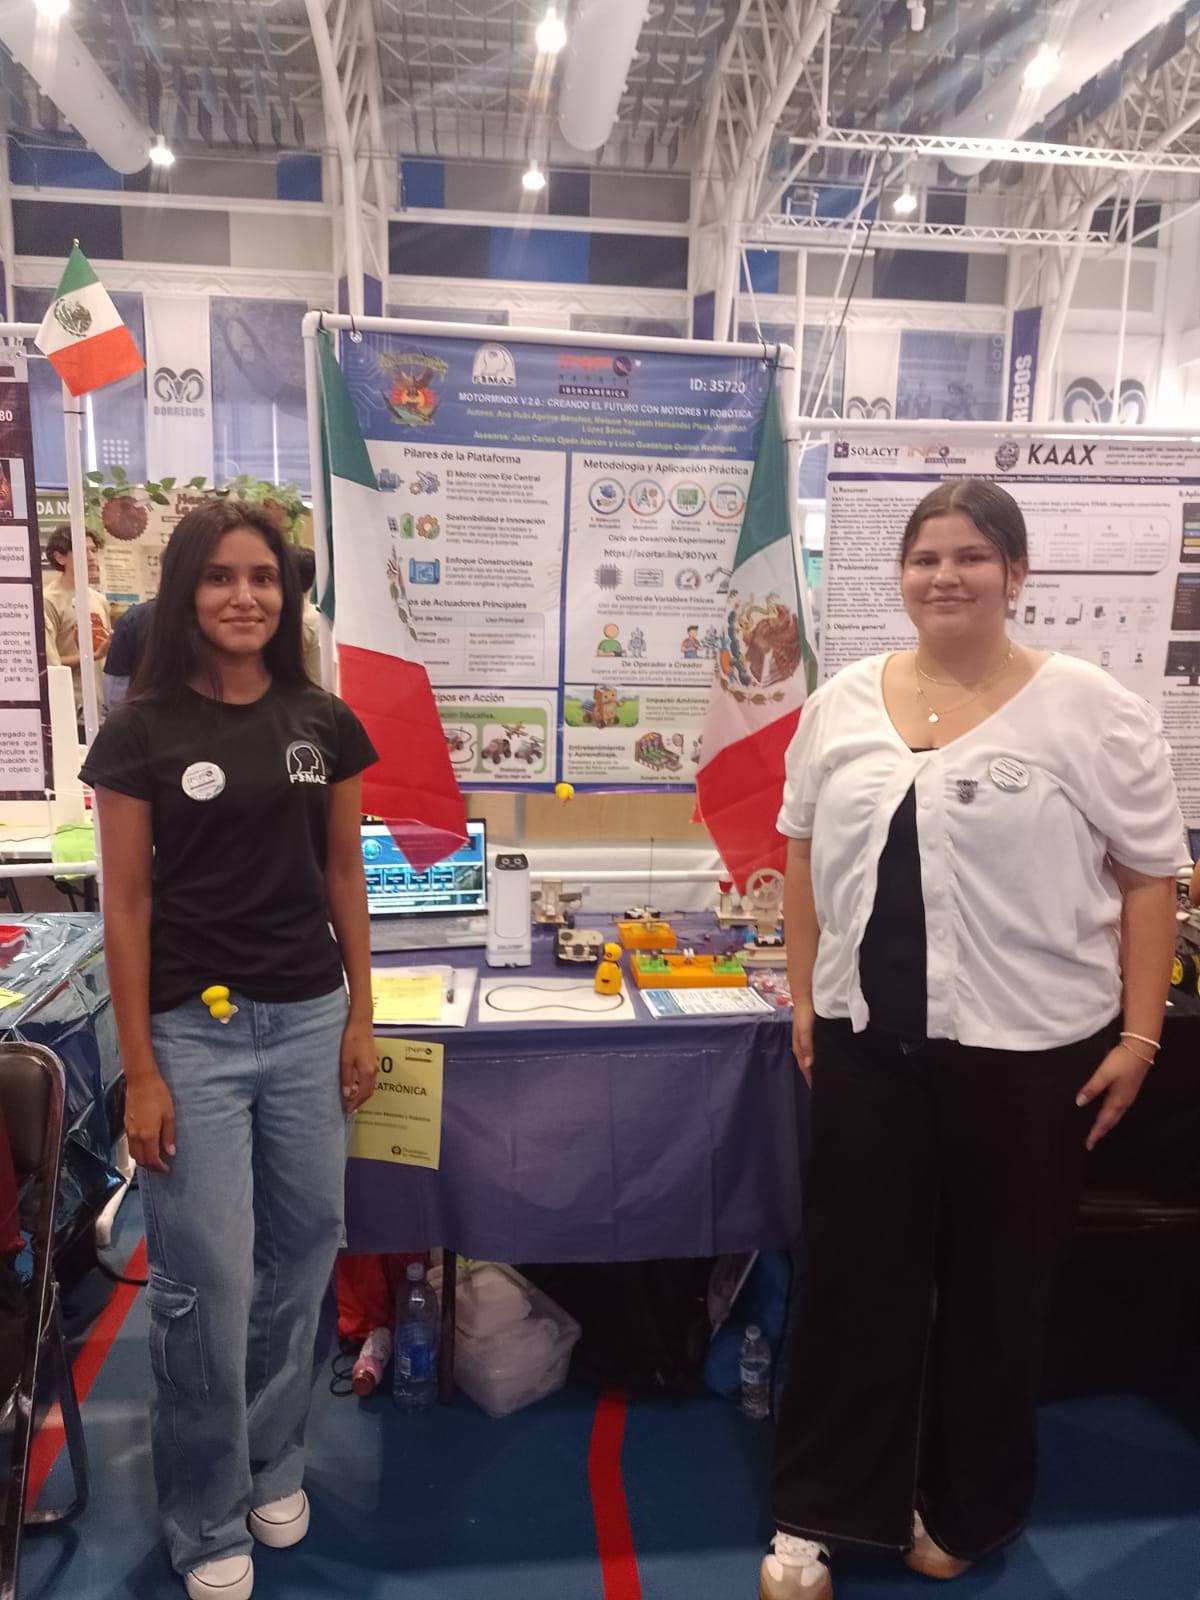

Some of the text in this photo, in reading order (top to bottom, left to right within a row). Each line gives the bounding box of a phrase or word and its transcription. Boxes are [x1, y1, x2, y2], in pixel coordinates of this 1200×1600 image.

[690, 378, 746, 394] ID: 35720
[154, 406, 206, 417] BORREGOS
[547, 398, 590, 410] CREANDO
[592, 401, 603, 410] EL
[605, 401, 638, 412] FUTURO
[641, 402, 659, 413] CON
[661, 405, 701, 417] MOTORES
[703, 408, 708, 417] Y
[404, 448, 521, 464] Pilares de la Plataforma
[850, 447, 900, 457] SOLACYT
[1028, 443, 1097, 466] KAAX
[584, 459, 749, 476] Metodología y Aplicación Práctica
[456, 471, 478, 479] Motor
[501, 473, 512, 481] Eje
[514, 474, 541, 482] Central
[446, 514, 498, 522] Sostenibilidad
[506, 516, 546, 525] Innovación
[640, 535, 678, 544] Desarrollo
[678, 536, 726, 546] Experimental
[446, 556, 534, 566] Enfoque Constructivista
[421, 598, 431, 607] de
[434, 598, 480, 608] Actuadores
[483, 600, 527, 610] Principales
[616, 594, 642, 602] Control
[654, 595, 688, 604] Variables
[634, 660, 666, 669] Operador
[473, 693, 504, 702] Acción
[374, 1082, 427, 1097] ATRÓNICA
